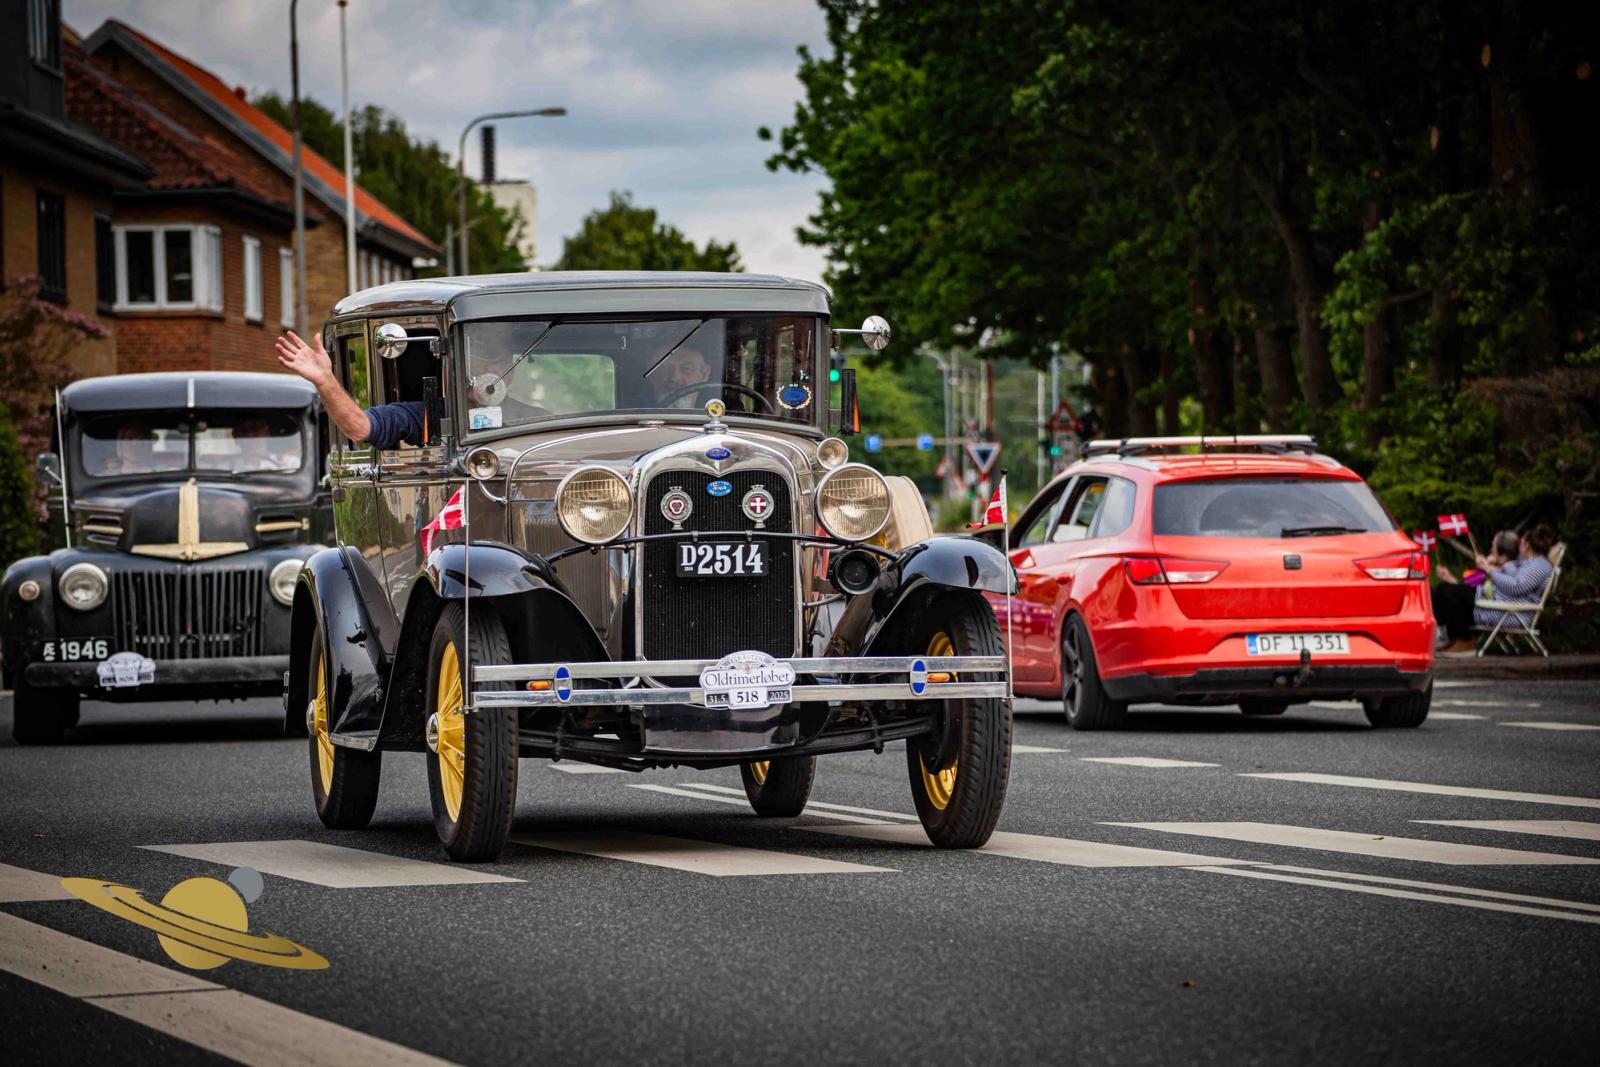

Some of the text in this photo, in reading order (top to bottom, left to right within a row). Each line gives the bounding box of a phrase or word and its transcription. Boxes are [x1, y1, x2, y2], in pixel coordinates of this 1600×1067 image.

[60, 640, 108, 660] 1946
[1260, 635, 1344, 651] DF 11 351
[737, 691, 758, 703] 518
[770, 691, 789, 700] 2025
